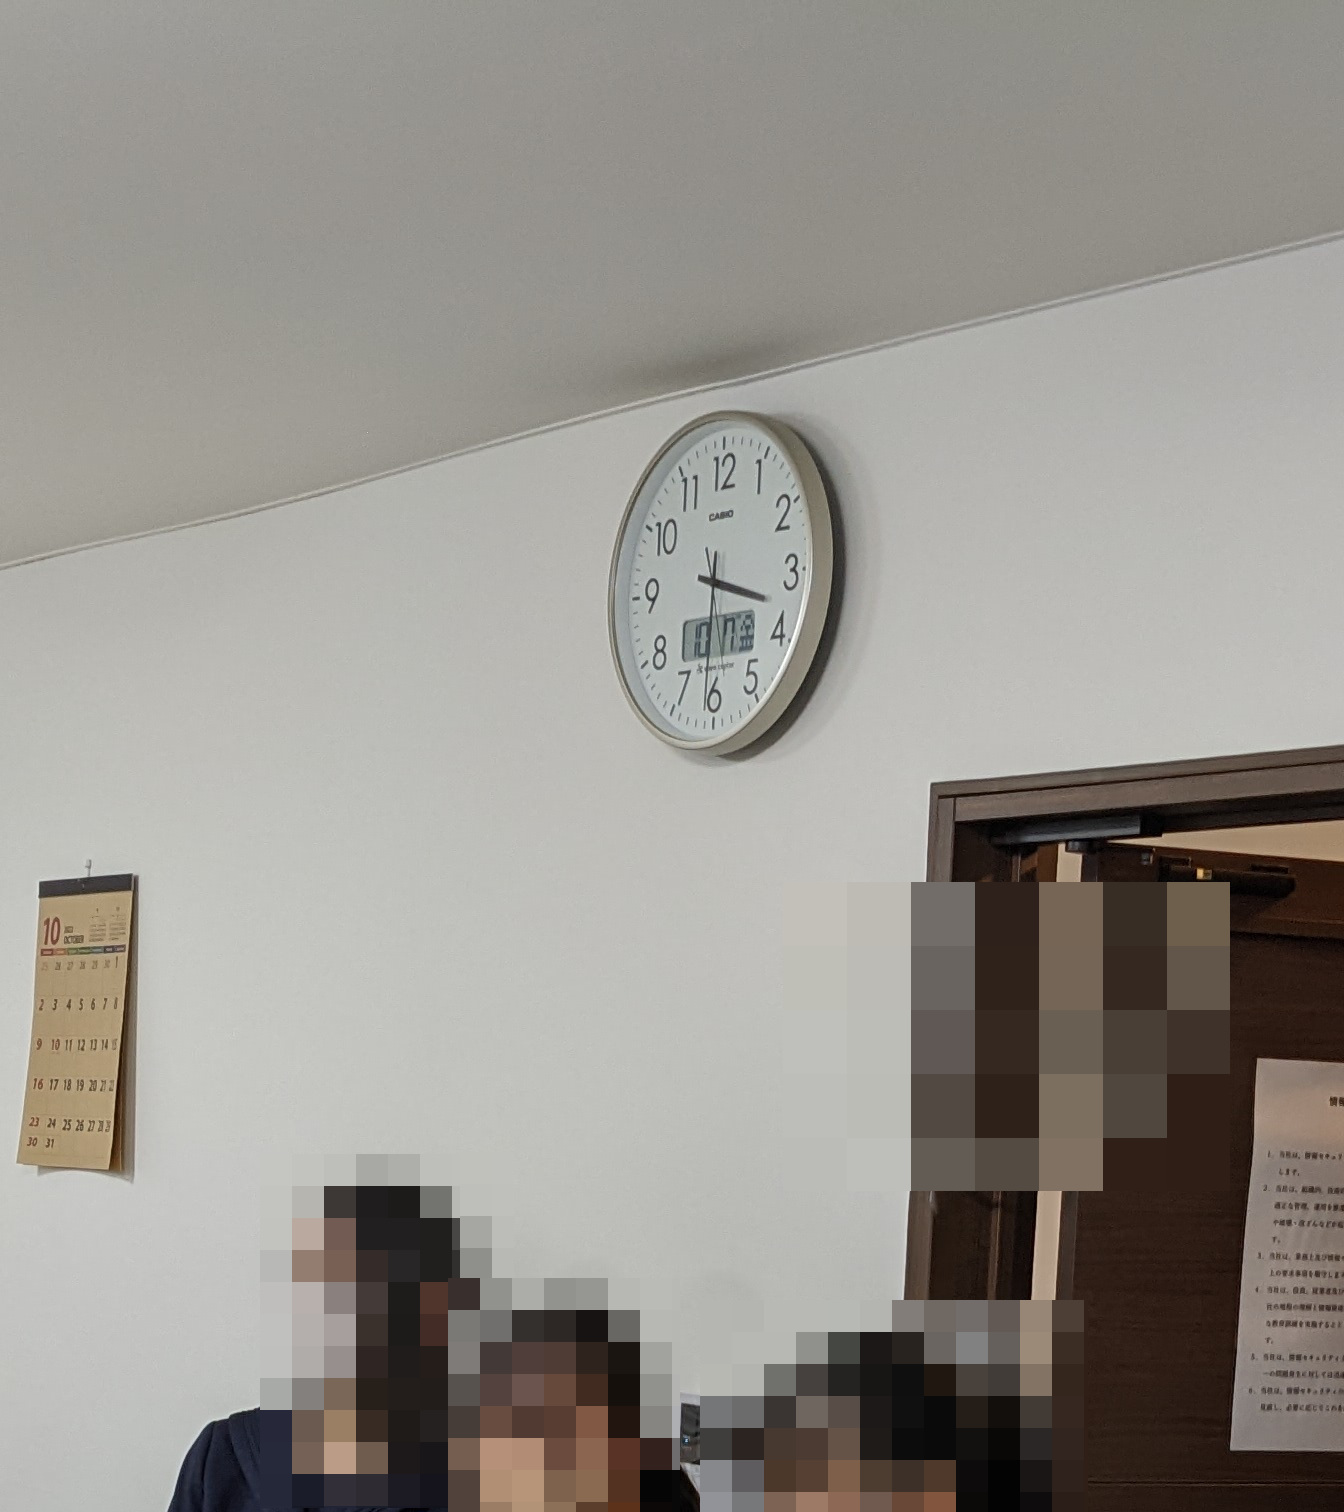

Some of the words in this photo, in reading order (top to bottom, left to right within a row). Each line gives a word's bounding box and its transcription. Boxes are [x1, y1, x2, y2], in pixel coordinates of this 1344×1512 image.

[713, 452, 736, 492] 12
[755, 458, 763, 495] 1
[681, 475, 699, 512] 11
[709, 509, 734, 522] CASIO
[774, 494, 790, 532] 2
[655, 519, 678, 556] 10
[783, 553, 799, 591] 3
[645, 578, 660, 614] 9
[770, 610, 785, 647] 4
[652, 634, 667, 670] 8
[677, 670, 692, 706] 7
[707, 676, 721, 713] 6
[743, 659, 759, 695] 5
[44, 917, 61, 945] 10
[39, 998, 45, 1011] 2
[52, 998, 58, 1011] 3
[66, 999, 72, 1011] 4
[79, 998, 84, 1011] 5
[91, 998, 96, 1011] 6
[103, 998, 108, 1010] 7
[36, 1038, 42, 1050] 9
[51, 1038, 60, 1051] 10
[65, 1039, 73, 1051] 11
[77, 1039, 86, 1051] 12
[90, 1039, 97, 1051] 13
[101, 1039, 109, 1050] 14
[33, 1078, 44, 1090] 16
[49, 1079, 59, 1090] 17
[63, 1079, 72, 1091] 18
[76, 1079, 84, 1091] 19
[27, 1136, 38, 1147] 30
[45, 1138, 55, 1149] 31
[29, 1117, 40, 1127] 23
[47, 1118, 56, 1129] 24
[62, 1119, 72, 1131] 25
[75, 1119, 84, 1132] 26
[87, 1120, 95, 1132] 27
